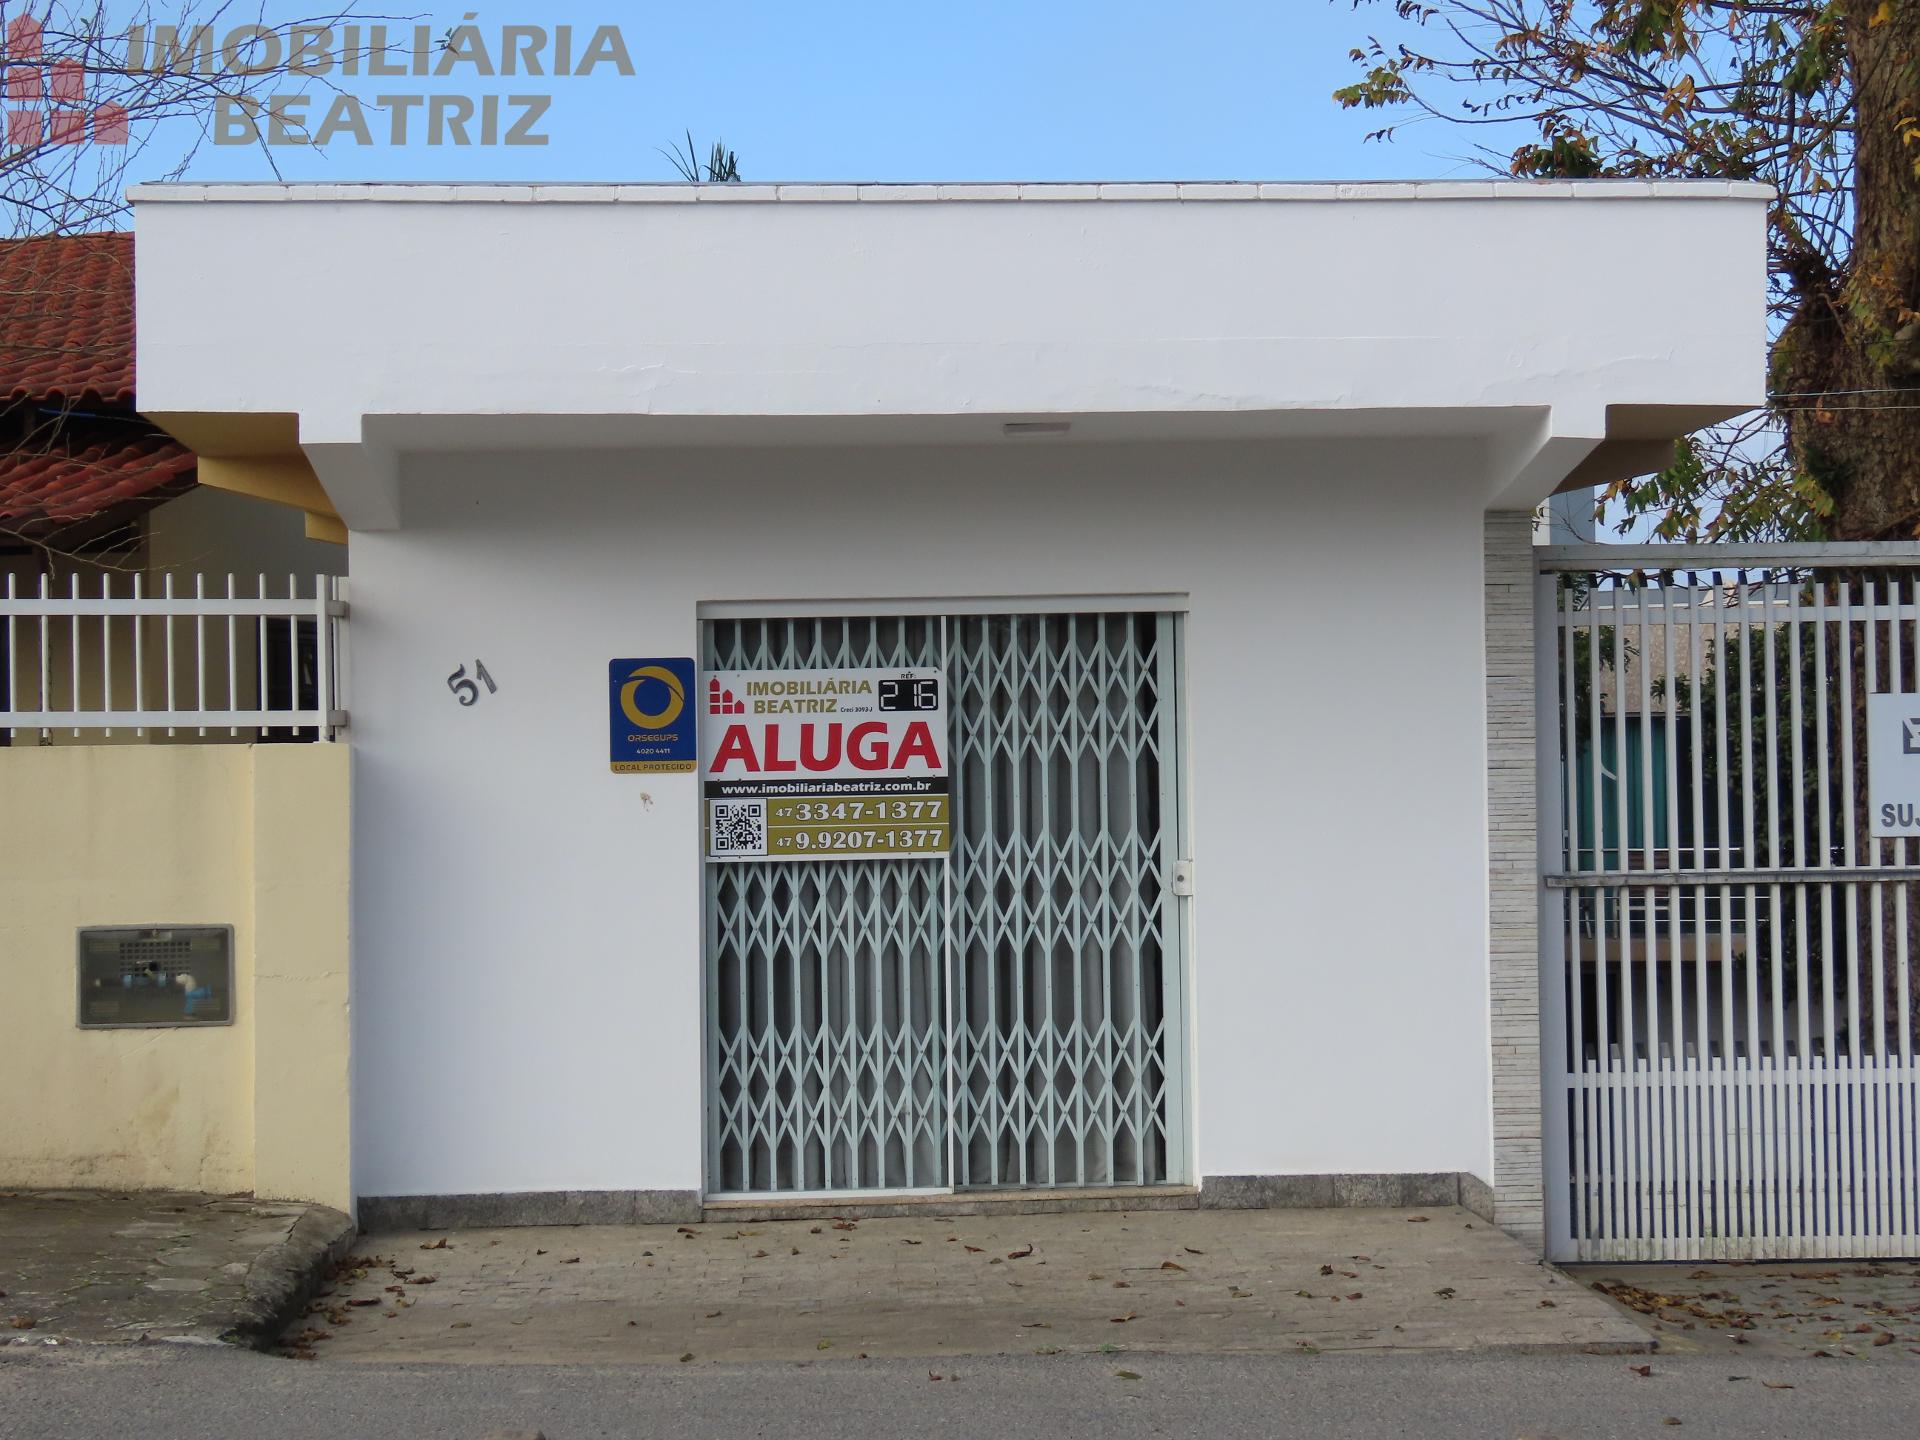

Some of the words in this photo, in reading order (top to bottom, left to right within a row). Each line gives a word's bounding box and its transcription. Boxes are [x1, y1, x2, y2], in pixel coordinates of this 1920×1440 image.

[447, 658, 497, 706] 51
[746, 678, 872, 696] IMOBILIÁRIA
[753, 699, 837, 714] BEATRIZ
[627, 733, 679, 742] ORSEGUPS
[709, 722, 942, 773] ALUGA
[643, 763, 692, 771] PROTEGIDO
[721, 781, 931, 794] www.imobiliariabeatriz.com.br
[775, 808, 793, 817] 47
[795, 801, 942, 821] 3347-1377
[776, 838, 792, 847] 47
[795, 829, 943, 850] 9.9207-1377
